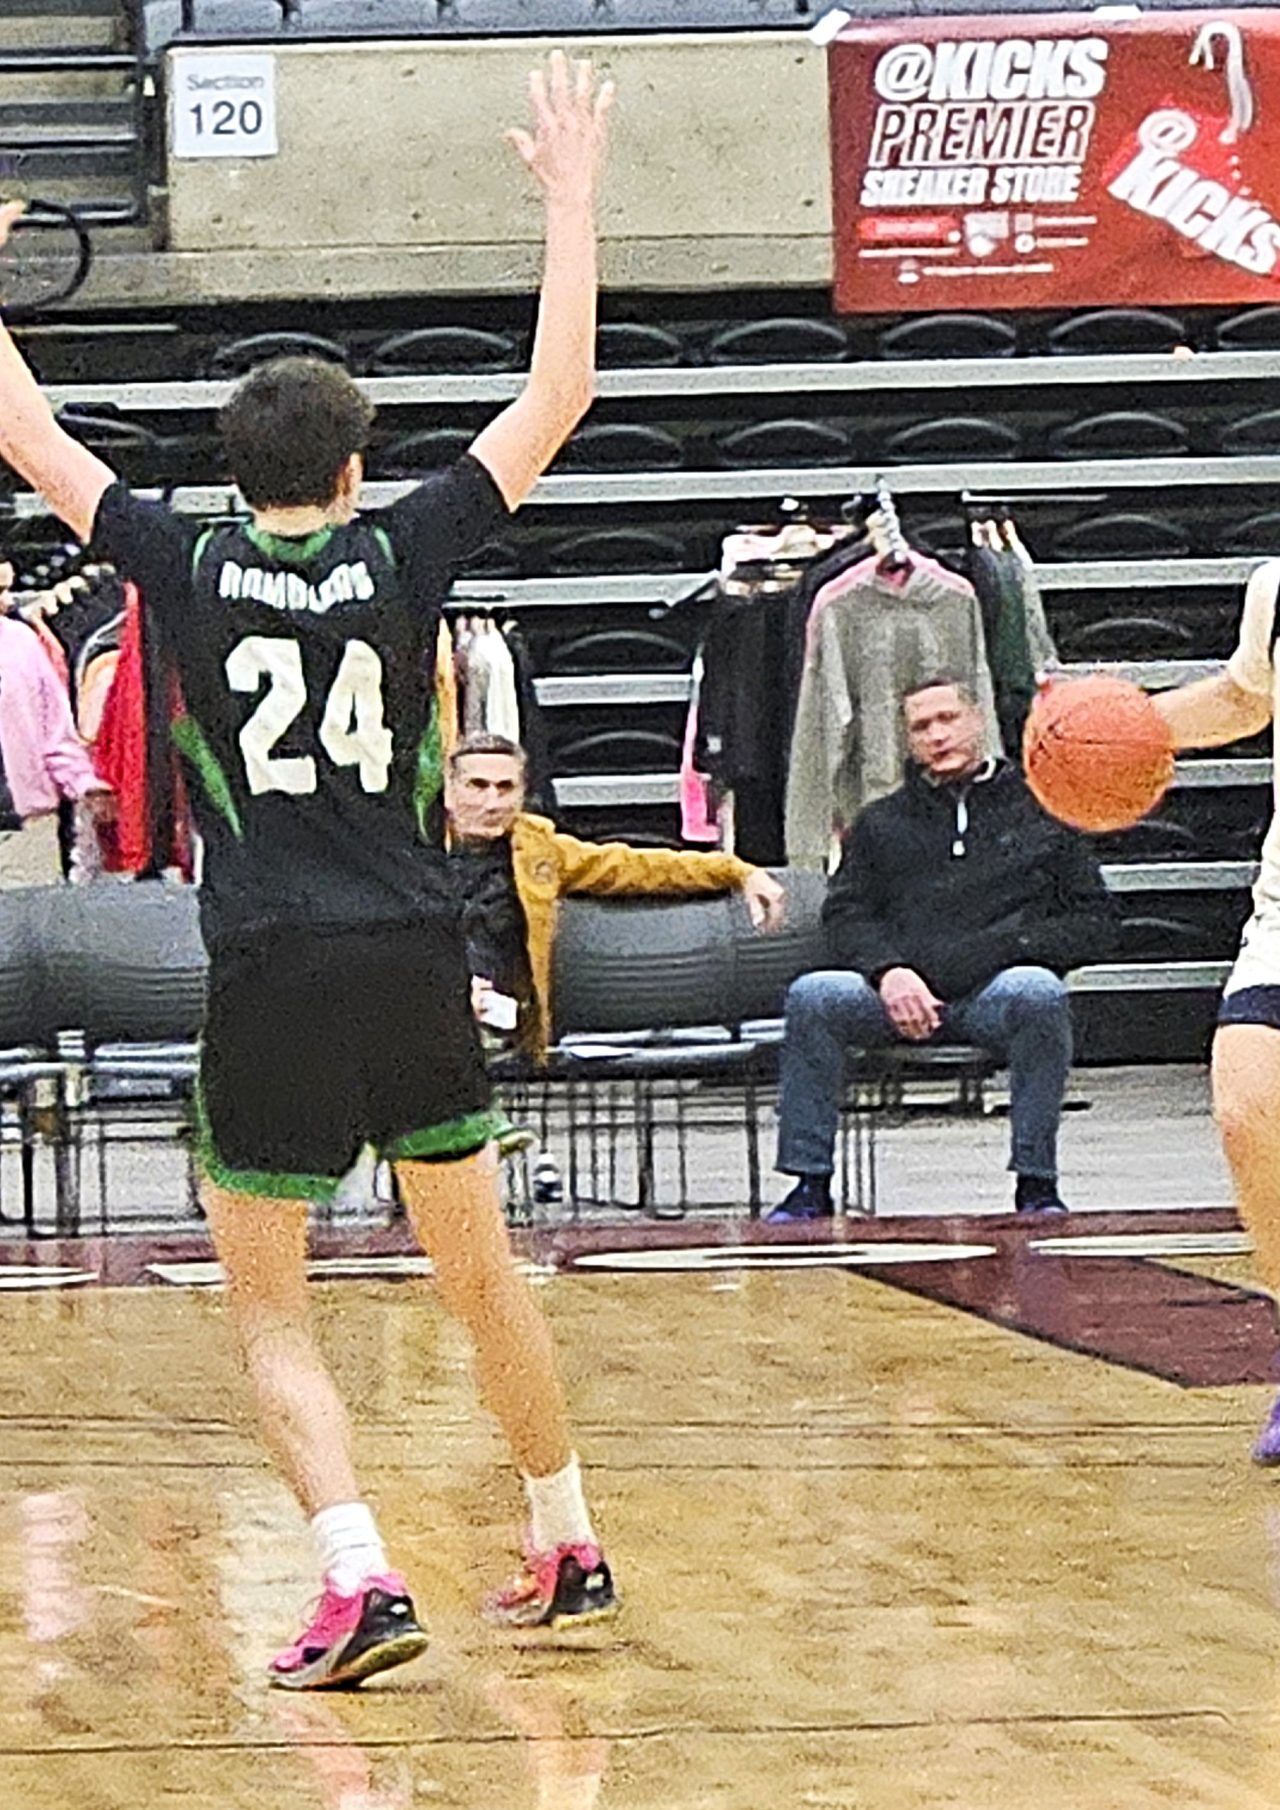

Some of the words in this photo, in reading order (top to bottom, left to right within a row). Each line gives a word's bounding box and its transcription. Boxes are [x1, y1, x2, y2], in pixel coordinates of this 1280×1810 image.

[186, 73, 264, 92] Section
[875, 38, 1109, 101] @KICKS
[189, 101, 263, 136] 120
[867, 101, 1096, 167] PREMIER
[991, 165, 1083, 203] STORE
[225, 635, 394, 795] 24
